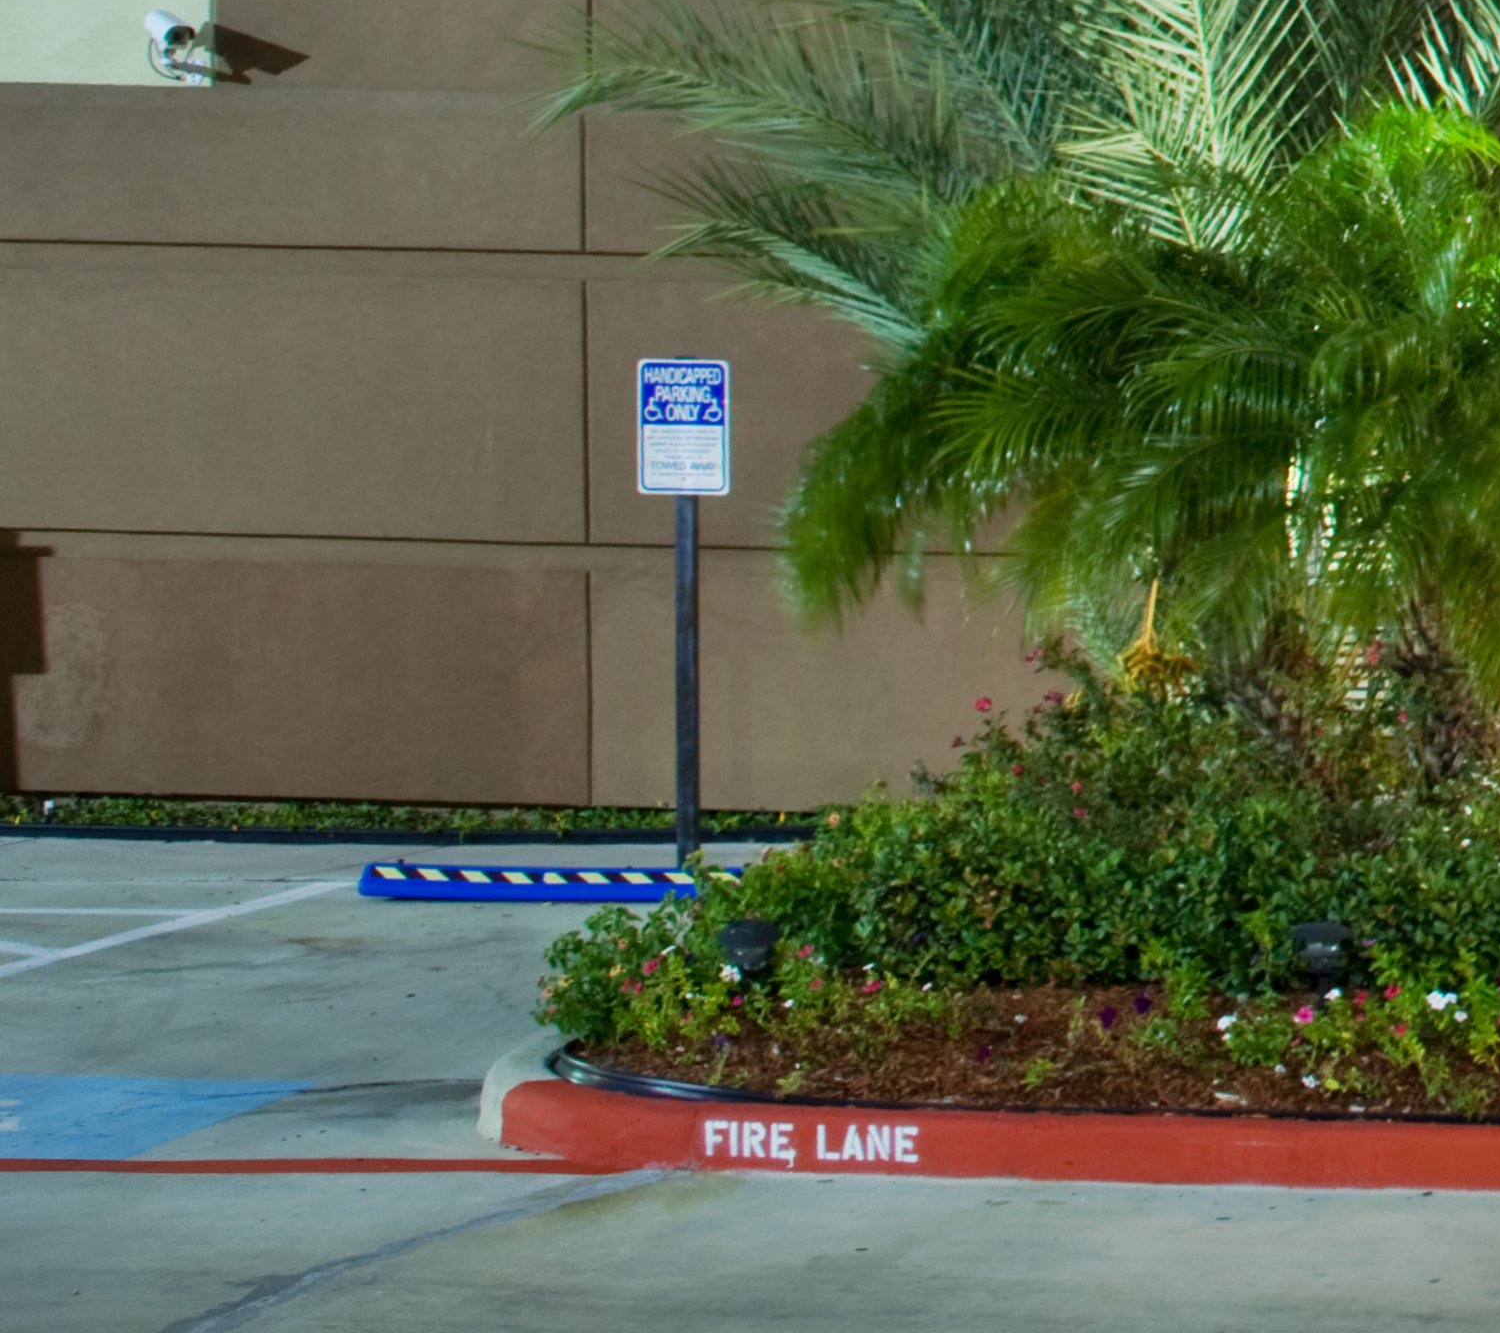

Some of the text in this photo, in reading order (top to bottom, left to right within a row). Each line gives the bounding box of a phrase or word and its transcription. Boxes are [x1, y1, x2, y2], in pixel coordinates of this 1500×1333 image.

[644, 367, 721, 385] HANDICAPPED
[655, 386, 711, 403] PARKING
[665, 404, 700, 421] ONLY
[651, 461, 687, 471] TOWED
[704, 1120, 919, 1162] FIRE LANE
